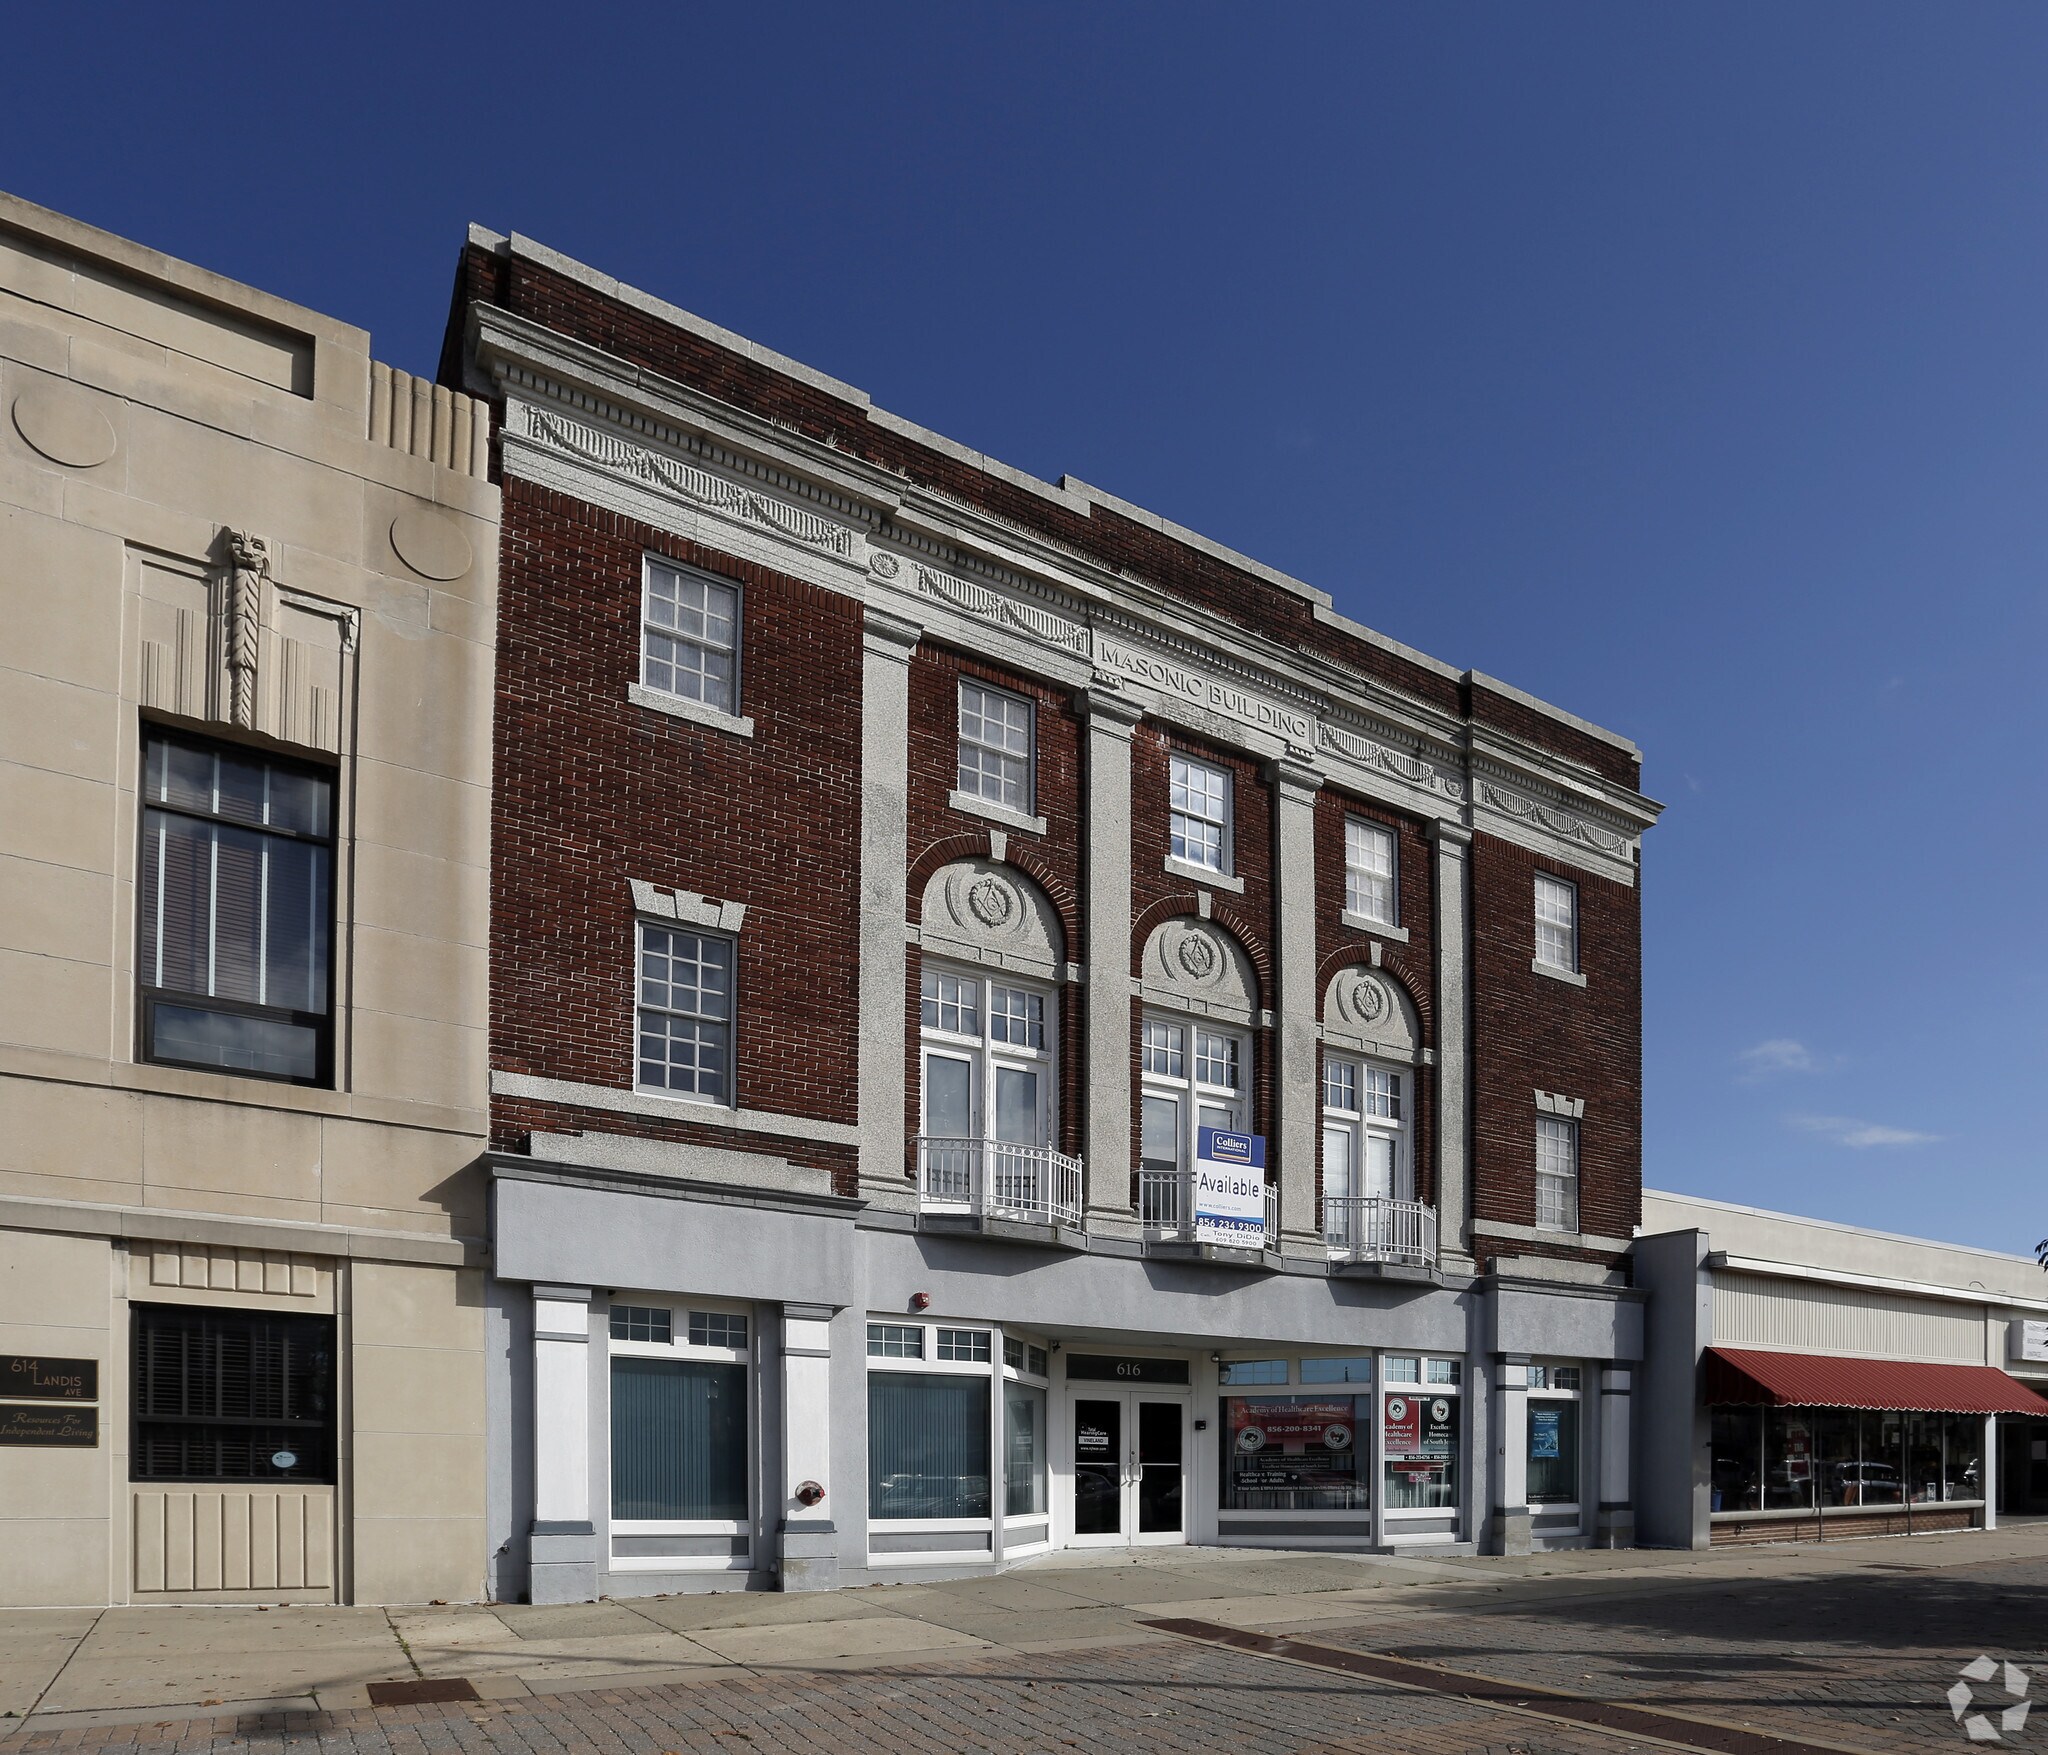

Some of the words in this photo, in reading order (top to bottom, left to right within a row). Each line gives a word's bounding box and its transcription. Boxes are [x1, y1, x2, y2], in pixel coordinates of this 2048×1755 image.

[1101, 642, 1202, 697] MASONIC
[1208, 684, 1306, 738] BUILDING
[1216, 1136, 1247, 1150] Colliers
[1216, 1145, 1246, 1154] INTERNATIONAL
[1199, 1172, 1259, 1198] Available
[1198, 1217, 1215, 1228] 856
[1218, 1219, 1235, 1230] 234
[1238, 1222, 1262, 1233] 9300
[1213, 1230, 1233, 1239] Tony
[1236, 1233, 1260, 1241] DiDio
[11, 1359, 39, 1373] 614
[1117, 1363, 1141, 1376] 616
[64, 1388, 82, 1397] AVE
[1241, 1404, 1269, 1414] Academy
[1270, 1404, 1278, 1413] of
[1278, 1404, 1313, 1413] Healthcare
[1314, 1404, 1348, 1412] Excellence
[12, 1412, 60, 1424] Resources
[63, 1414, 80, 1424] For
[0, 1424, 55, 1437] Independent
[57, 1425, 94, 1439] Living
[1267, 1425, 1322, 1433] 856-200-8341
[1384, 1423, 1406, 1431] cademy
[1406, 1422, 1414, 1430] of
